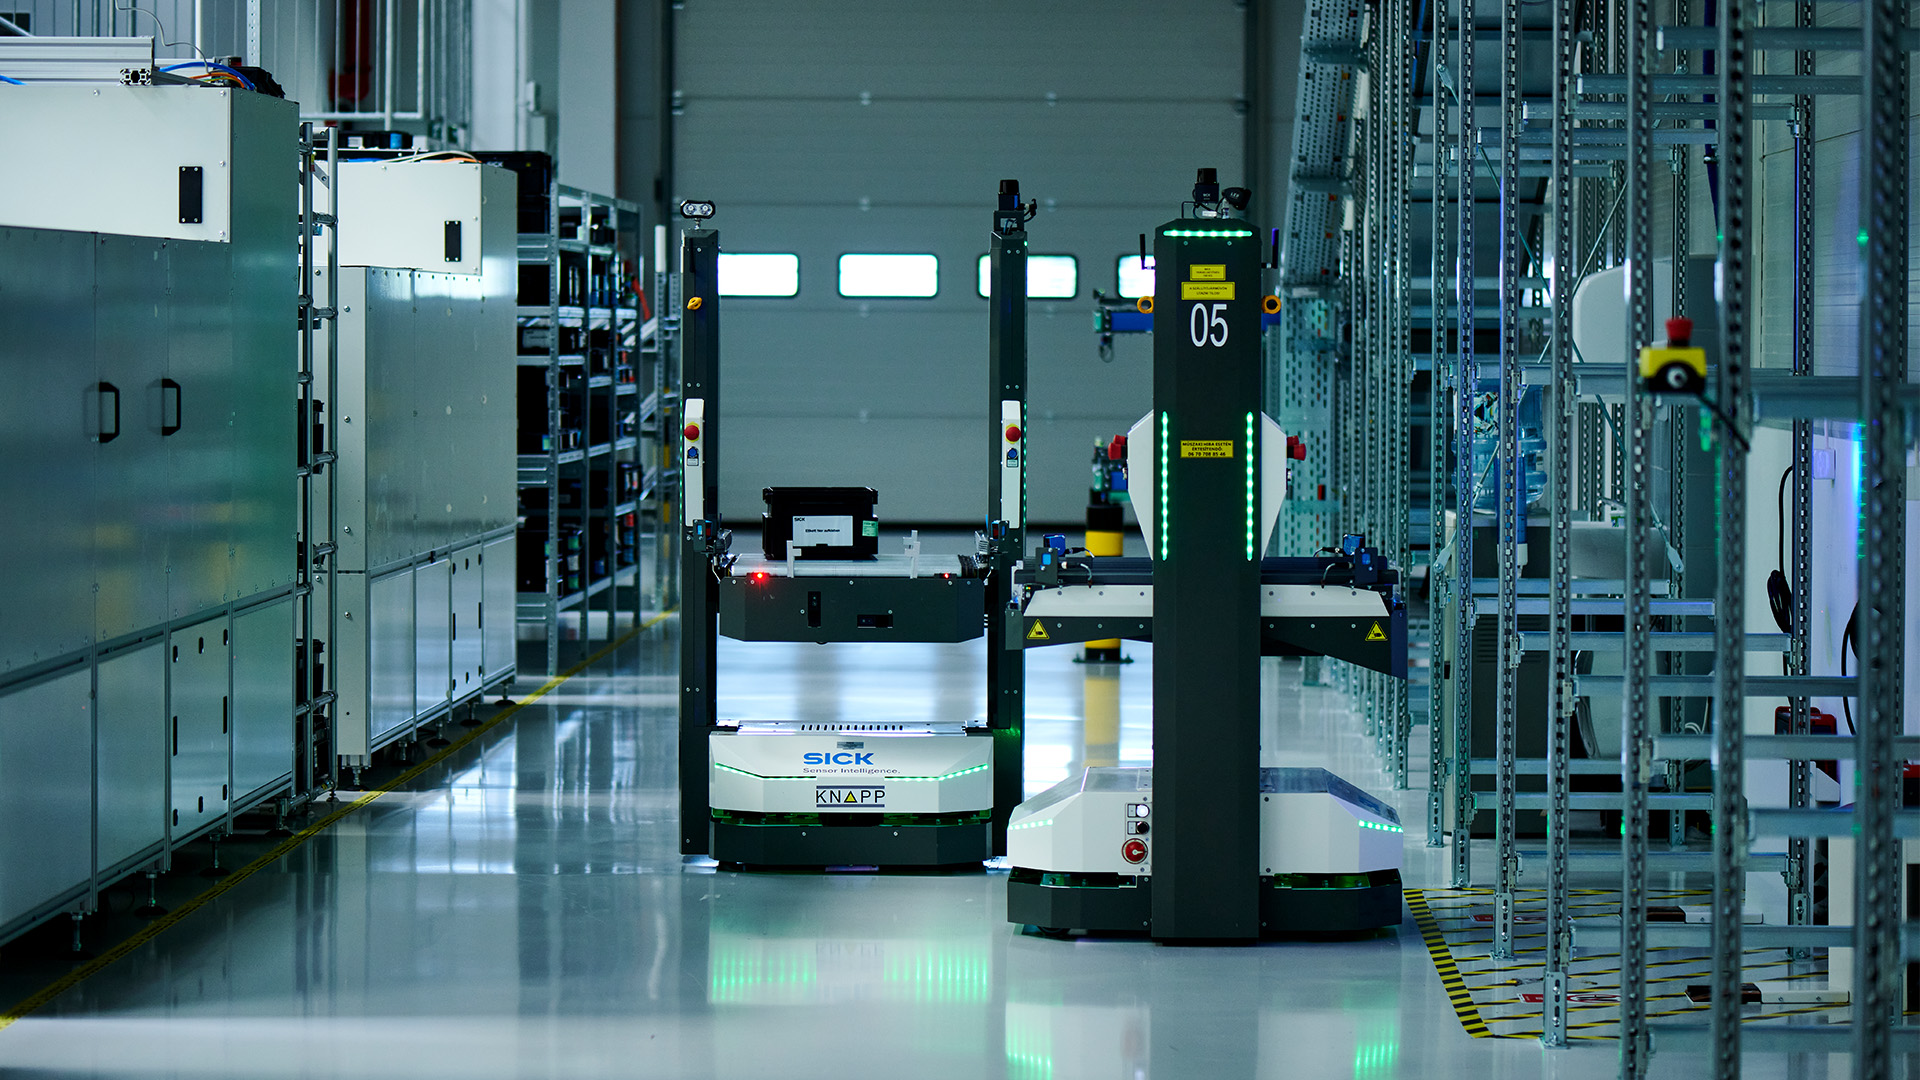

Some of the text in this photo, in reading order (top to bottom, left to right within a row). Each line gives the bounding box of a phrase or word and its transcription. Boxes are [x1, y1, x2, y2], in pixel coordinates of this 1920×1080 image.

[1190, 302, 1229, 347] 05
[803, 752, 874, 765] SICK
[816, 790, 885, 803] KNAPP
